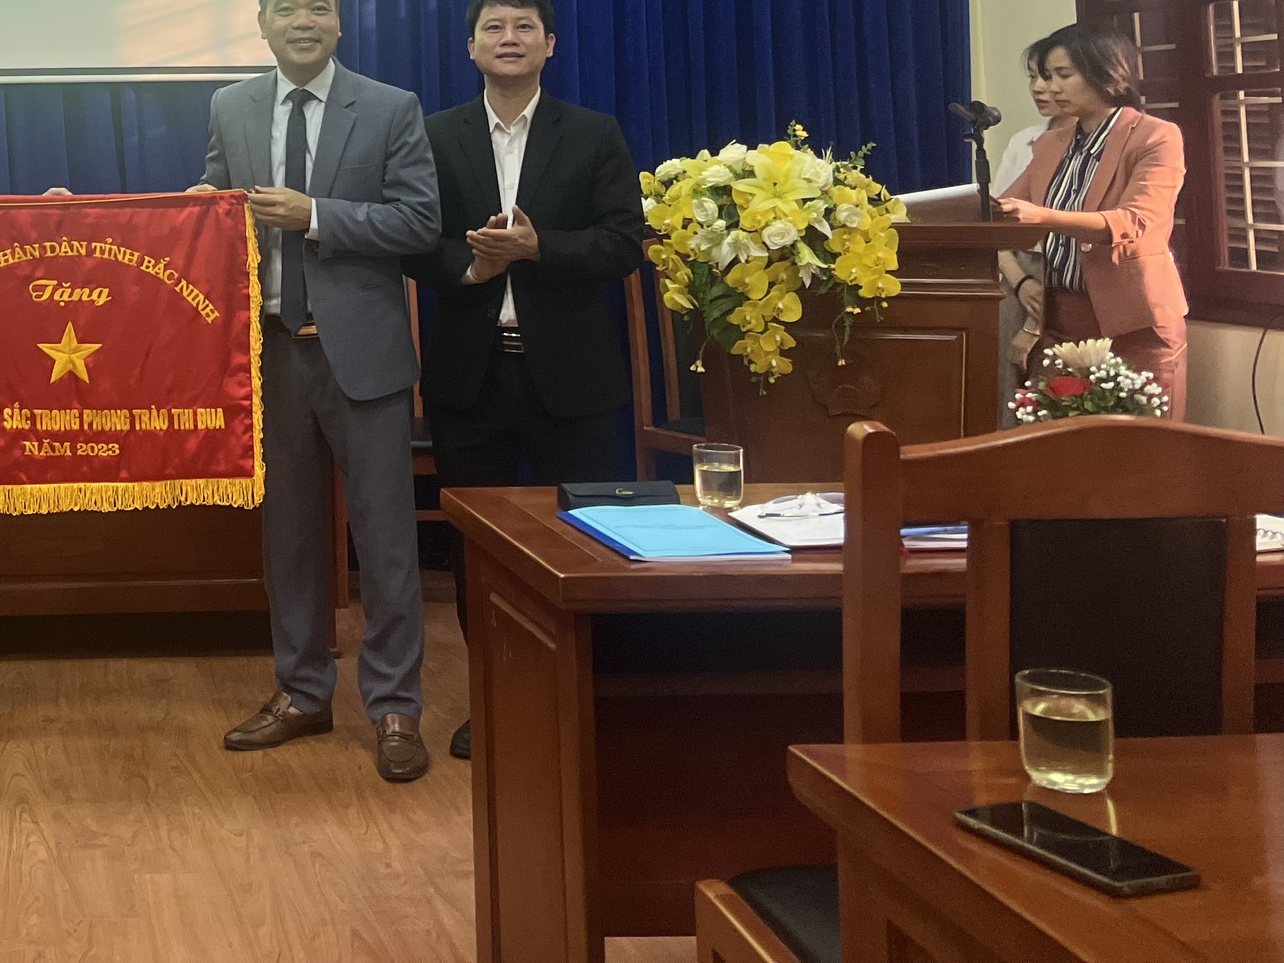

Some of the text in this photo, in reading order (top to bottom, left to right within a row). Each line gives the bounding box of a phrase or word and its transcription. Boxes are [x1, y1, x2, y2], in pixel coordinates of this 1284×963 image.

[28, 279, 112, 307] Tặng
[43, 236, 87, 257] DÂN
[91, 237, 141, 267] TỈNH
[139, 256, 179, 285] BẮC
[173, 277, 220, 324] NINH
[3, 401, 32, 430] SẮC
[33, 408, 81, 432] TRONG
[82, 408, 131, 432] PHONG
[132, 404, 169, 431] TRÀO
[171, 407, 195, 430] THI
[23, 438, 121, 458] NĂM 2023
